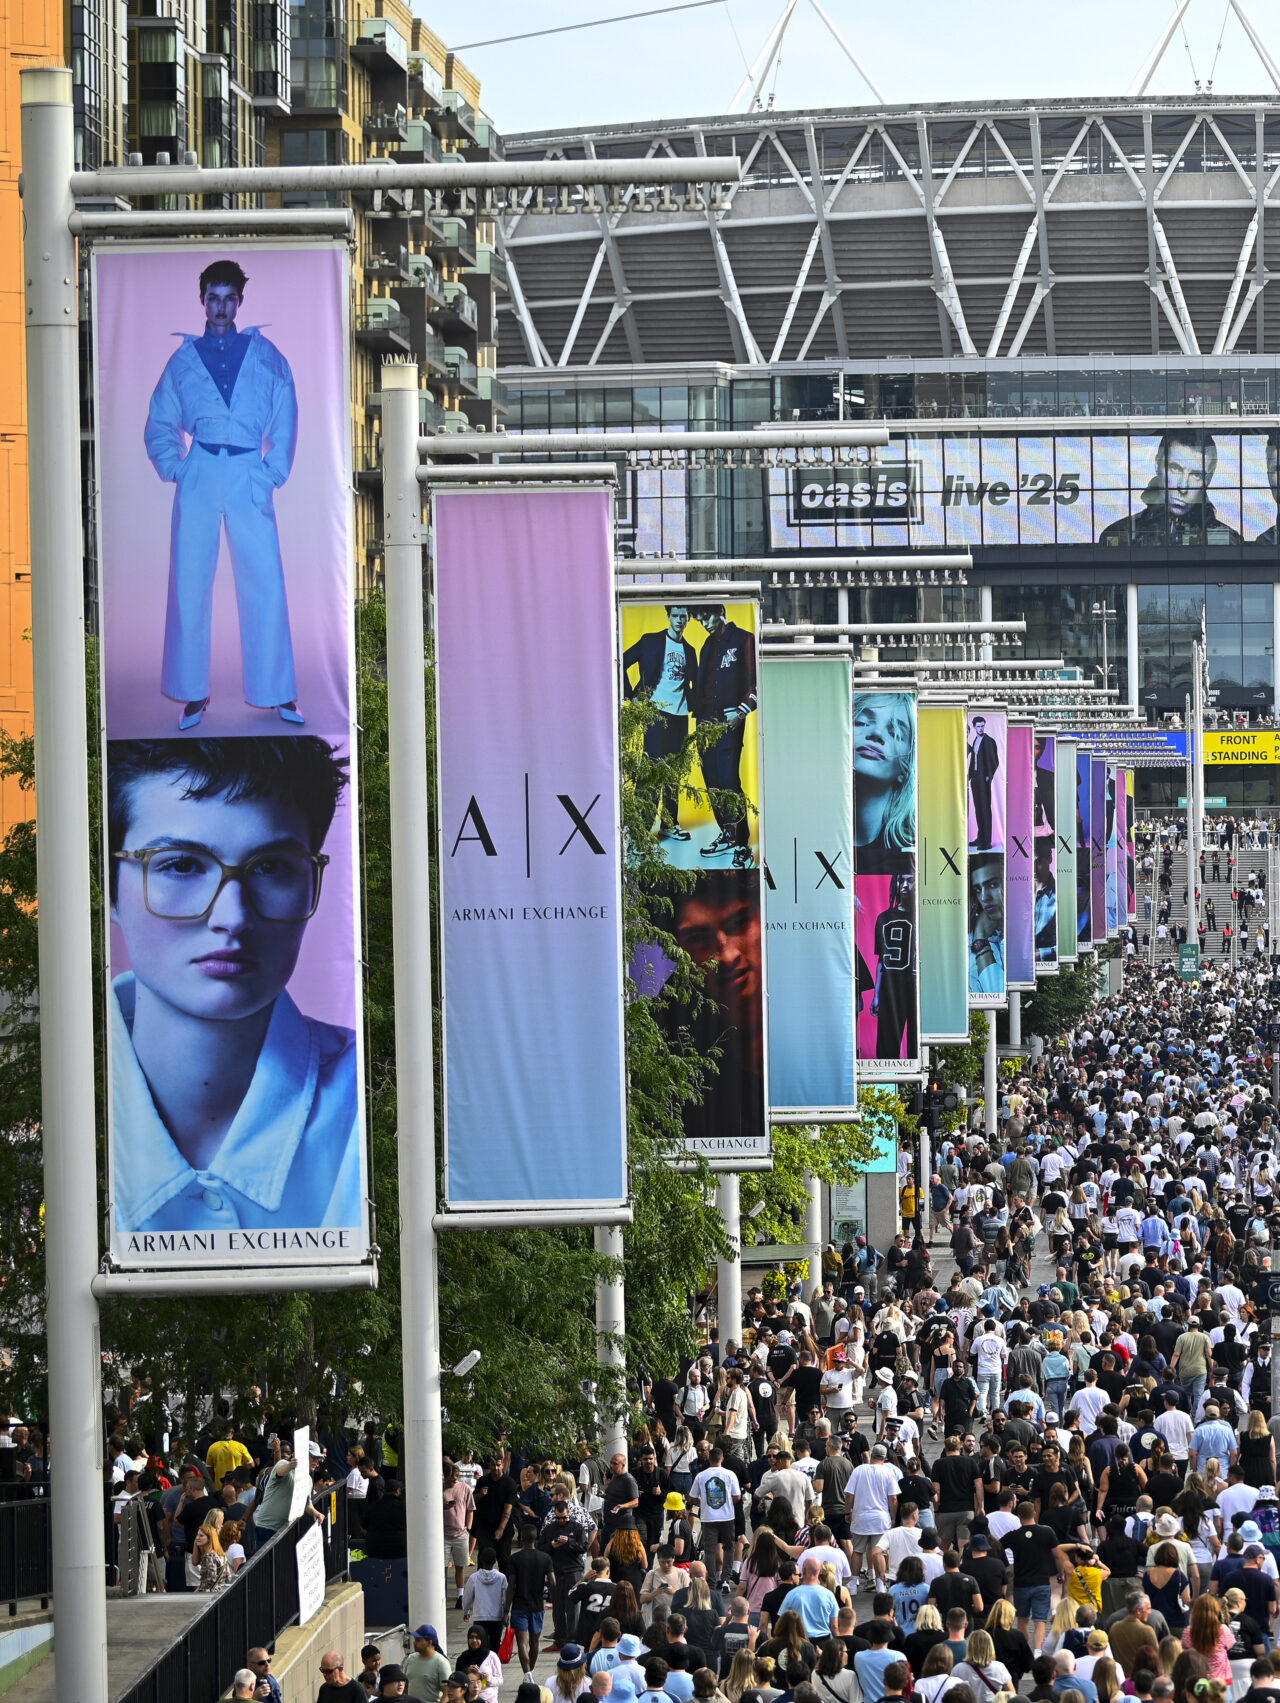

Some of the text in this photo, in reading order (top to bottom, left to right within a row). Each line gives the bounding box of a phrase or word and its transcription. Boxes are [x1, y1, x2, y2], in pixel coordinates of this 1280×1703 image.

[801, 475, 908, 508] oasis
[940, 473, 1081, 507] live '25
[1220, 735, 1257, 744] FRONT
[1211, 751, 1268, 760] STANDING
[452, 906, 609, 921] ARMANI EXCHANGE
[792, 921, 846, 931] EXCHANGE
[883, 919, 912, 970] 9
[868, 1060, 914, 1068] EXCHANGE
[693, 1138, 759, 1150] EXCHANGE
[128, 1230, 351, 1252] ARMANI EXCHANGE
[901, 1598, 920, 1620] 19
